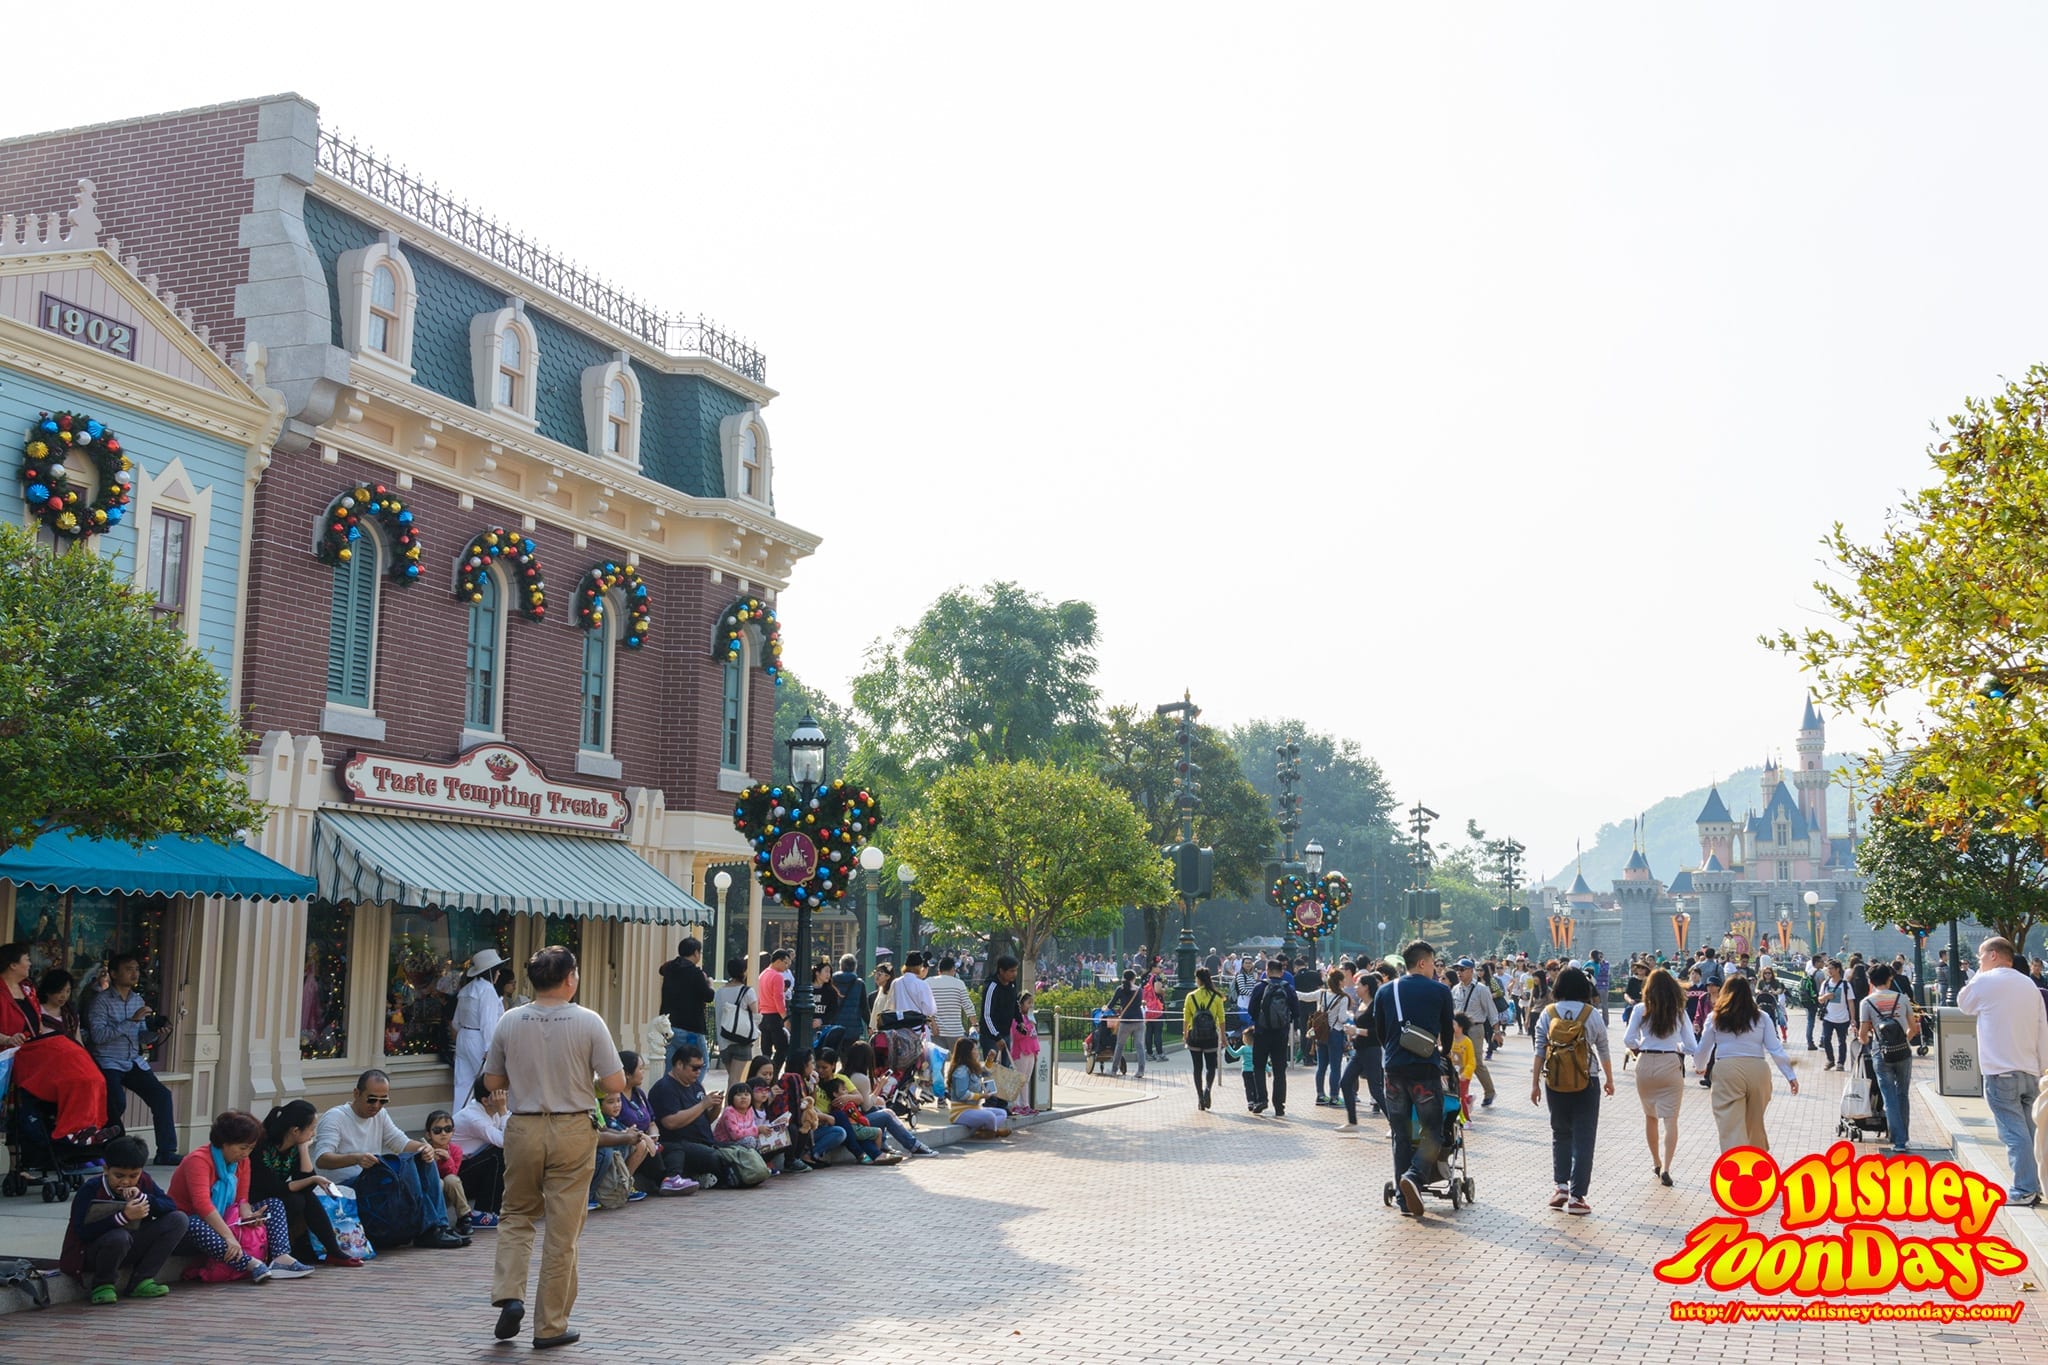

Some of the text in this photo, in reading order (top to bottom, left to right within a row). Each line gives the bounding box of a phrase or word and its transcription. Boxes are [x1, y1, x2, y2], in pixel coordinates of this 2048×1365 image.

[47, 304, 130, 353] 1902
[373, 766, 608, 818] Taste Tempting Treats
